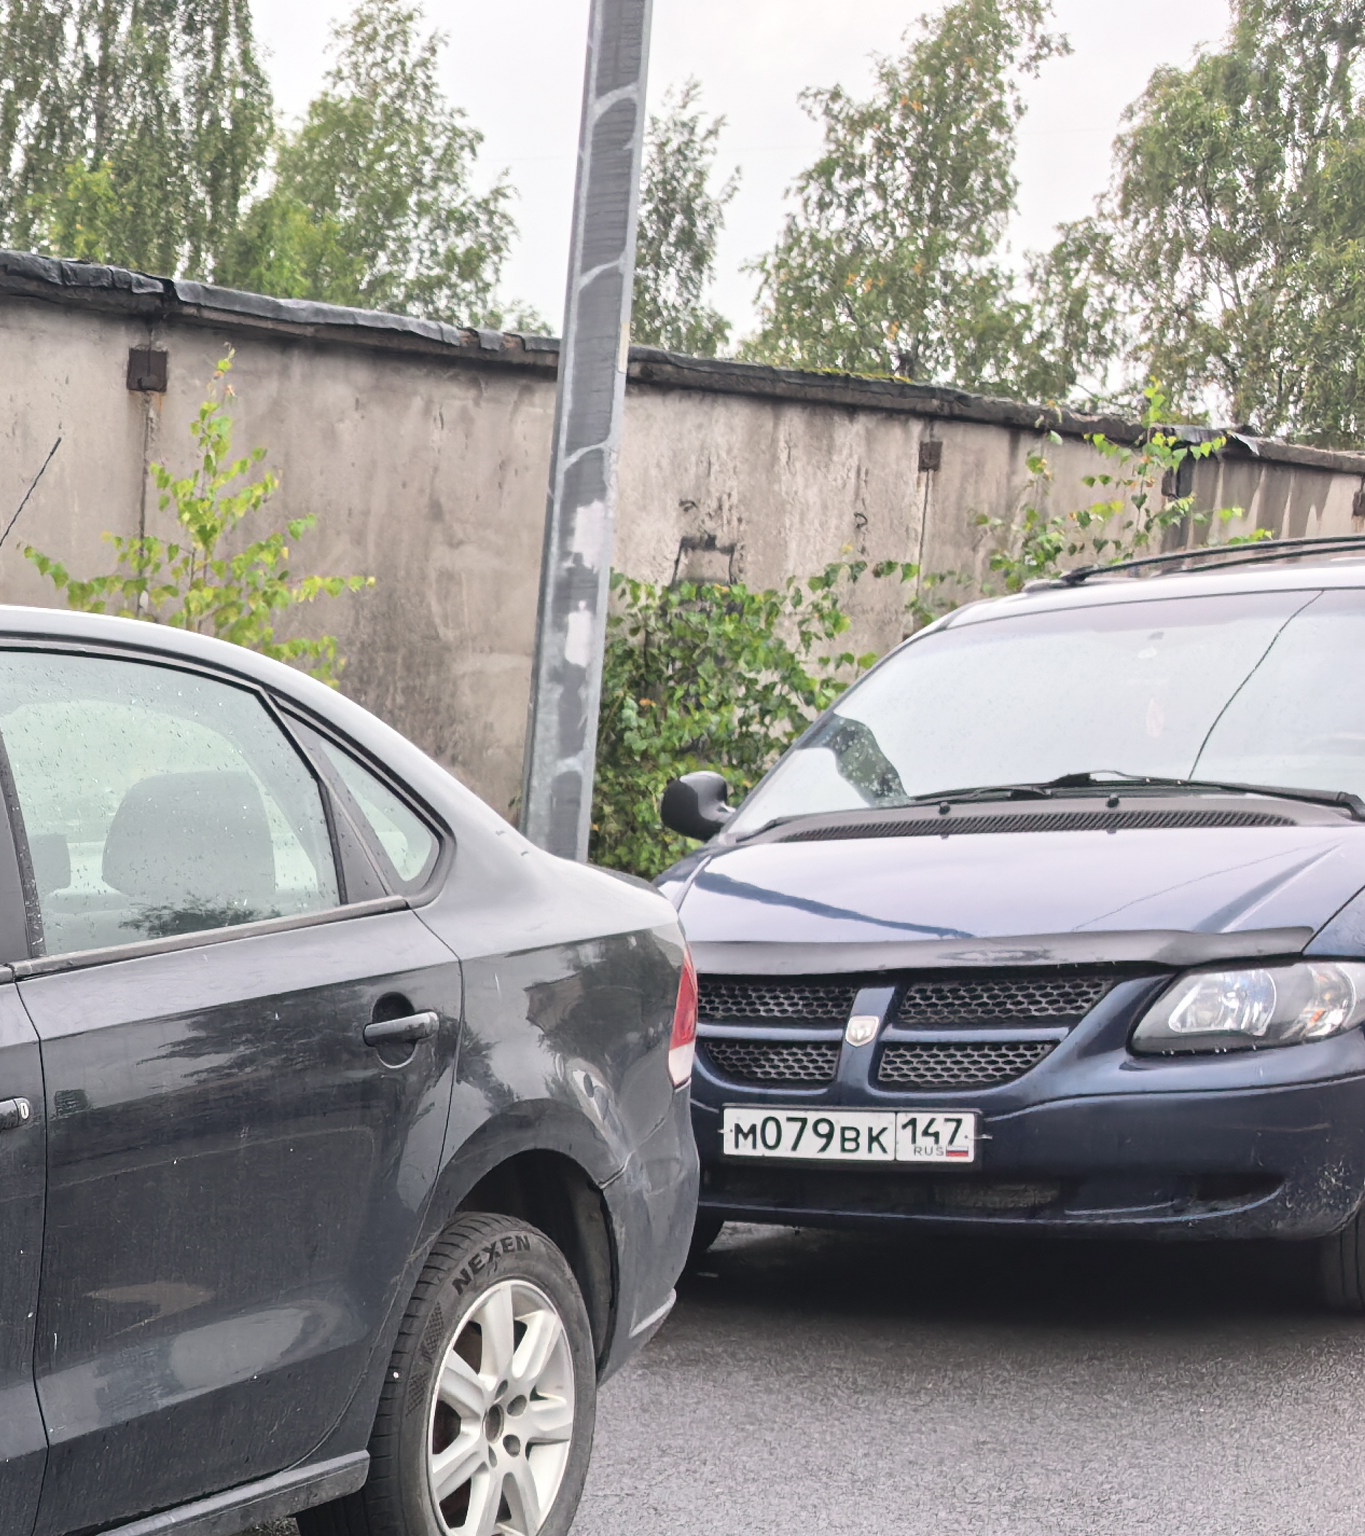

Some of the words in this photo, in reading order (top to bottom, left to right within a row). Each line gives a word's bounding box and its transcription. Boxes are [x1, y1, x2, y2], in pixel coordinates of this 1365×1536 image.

[733, 1116, 889, 1154] М079ВК
[901, 1117, 963, 1146] 147
[913, 1145, 945, 1157] RUS
[452, 1234, 531, 1295] NEXEN
